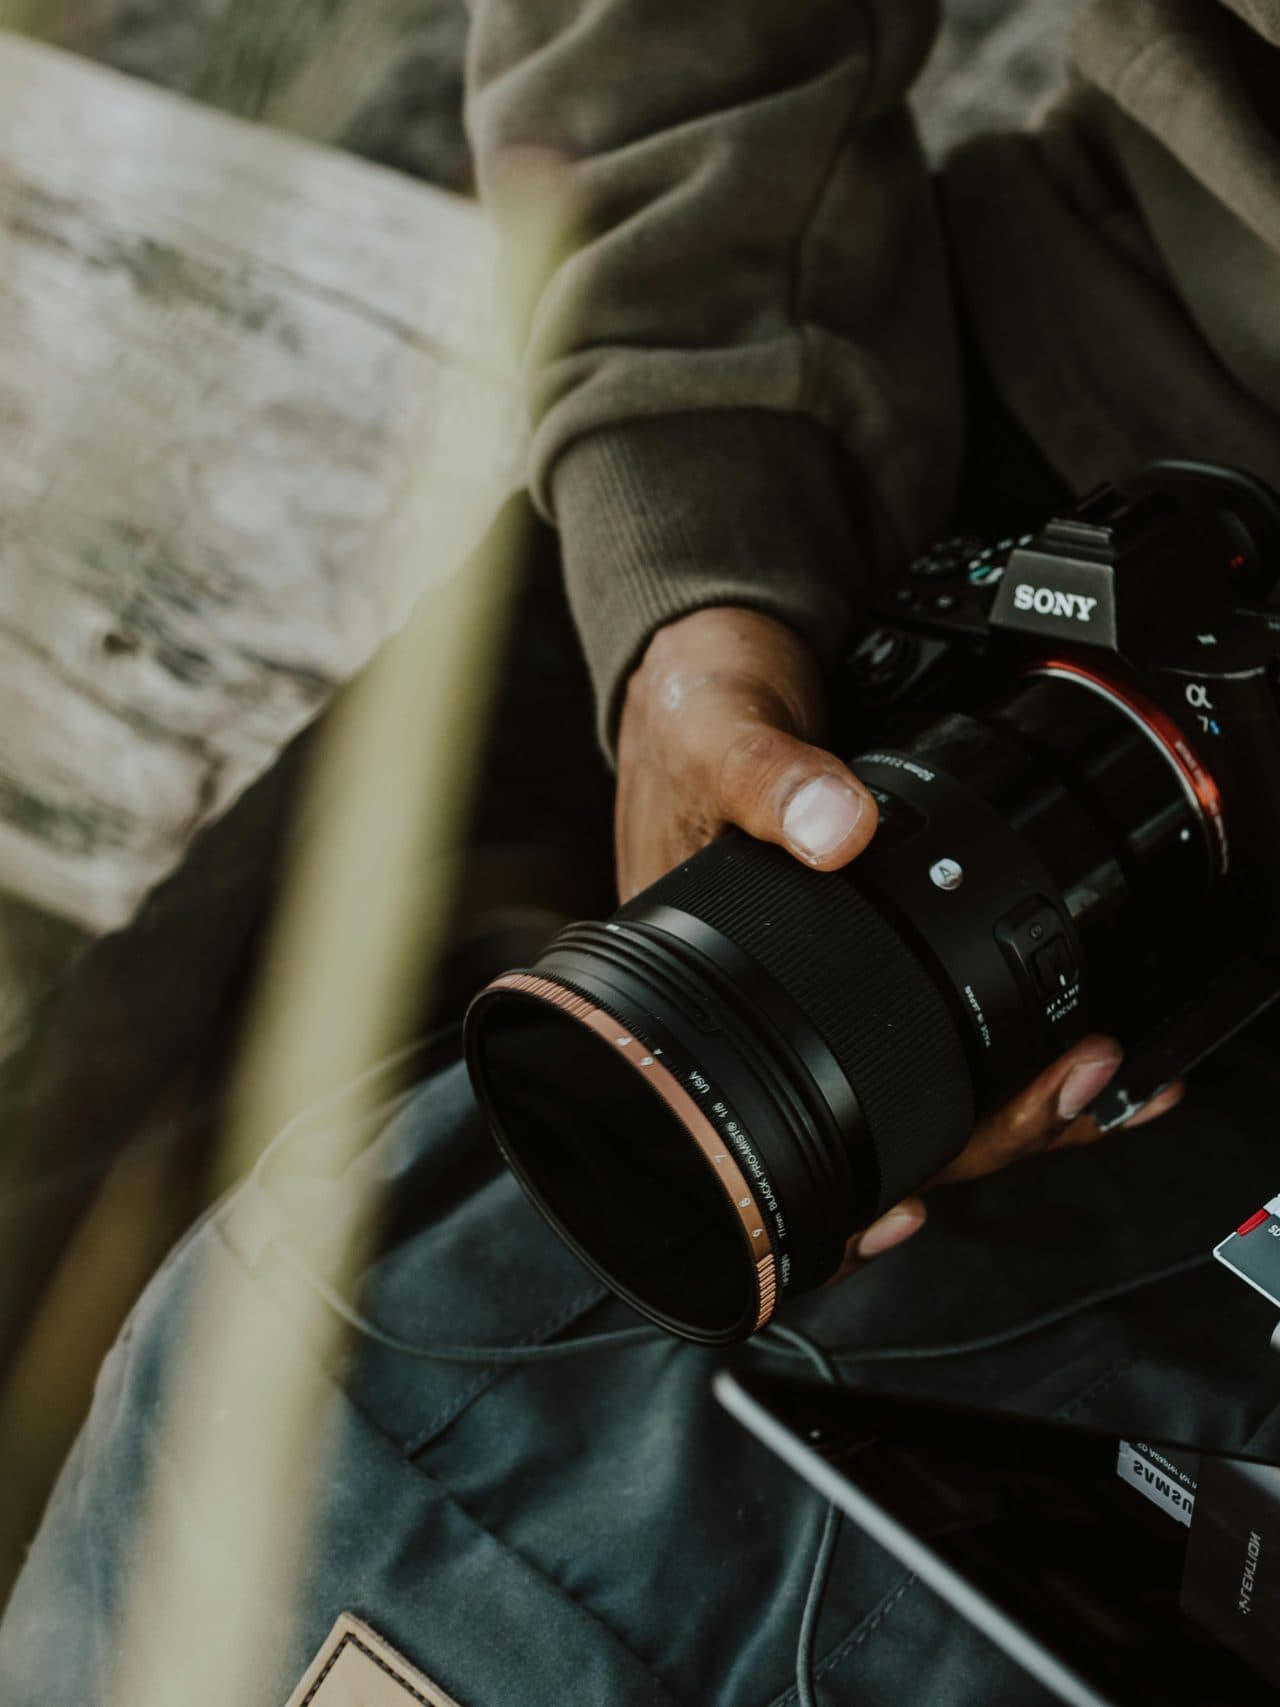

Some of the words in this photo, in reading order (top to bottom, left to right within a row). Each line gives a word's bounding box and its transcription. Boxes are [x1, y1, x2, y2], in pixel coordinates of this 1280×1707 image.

[1014, 584, 1097, 622] SONY
[688, 1070, 710, 1094] USA
[758, 1178, 778, 1211] BLACK
